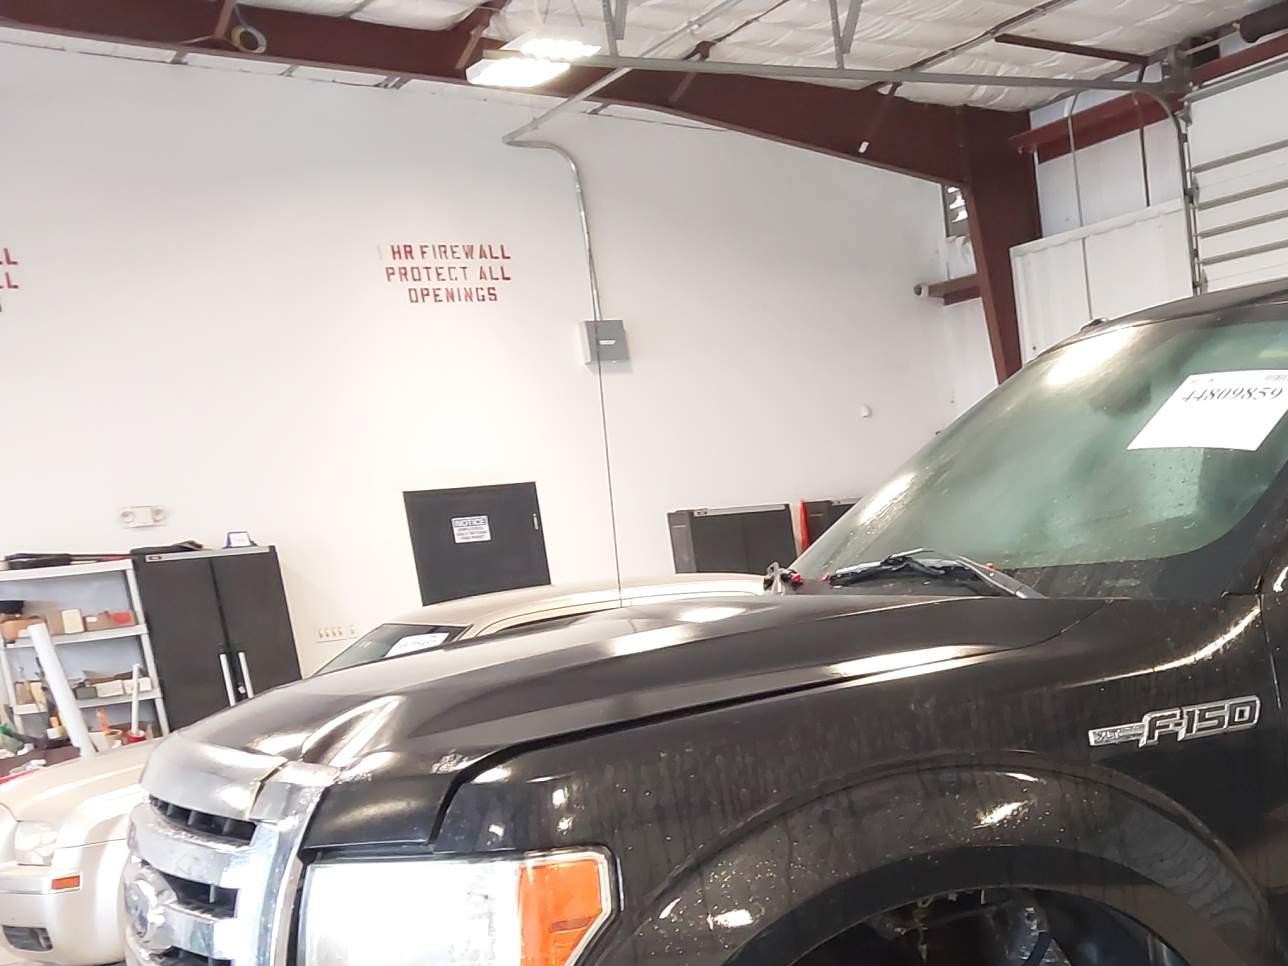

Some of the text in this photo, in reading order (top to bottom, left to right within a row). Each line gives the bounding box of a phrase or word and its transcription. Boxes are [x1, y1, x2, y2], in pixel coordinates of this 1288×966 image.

[390, 244, 414, 260] HR
[420, 244, 511, 260] FIREWALL
[385, 265, 511, 282] PROTECT ALL
[408, 287, 498, 303] OPENINGS
[1182, 387, 1284, 402] 44809859
[1138, 695, 1261, 748] F-150
